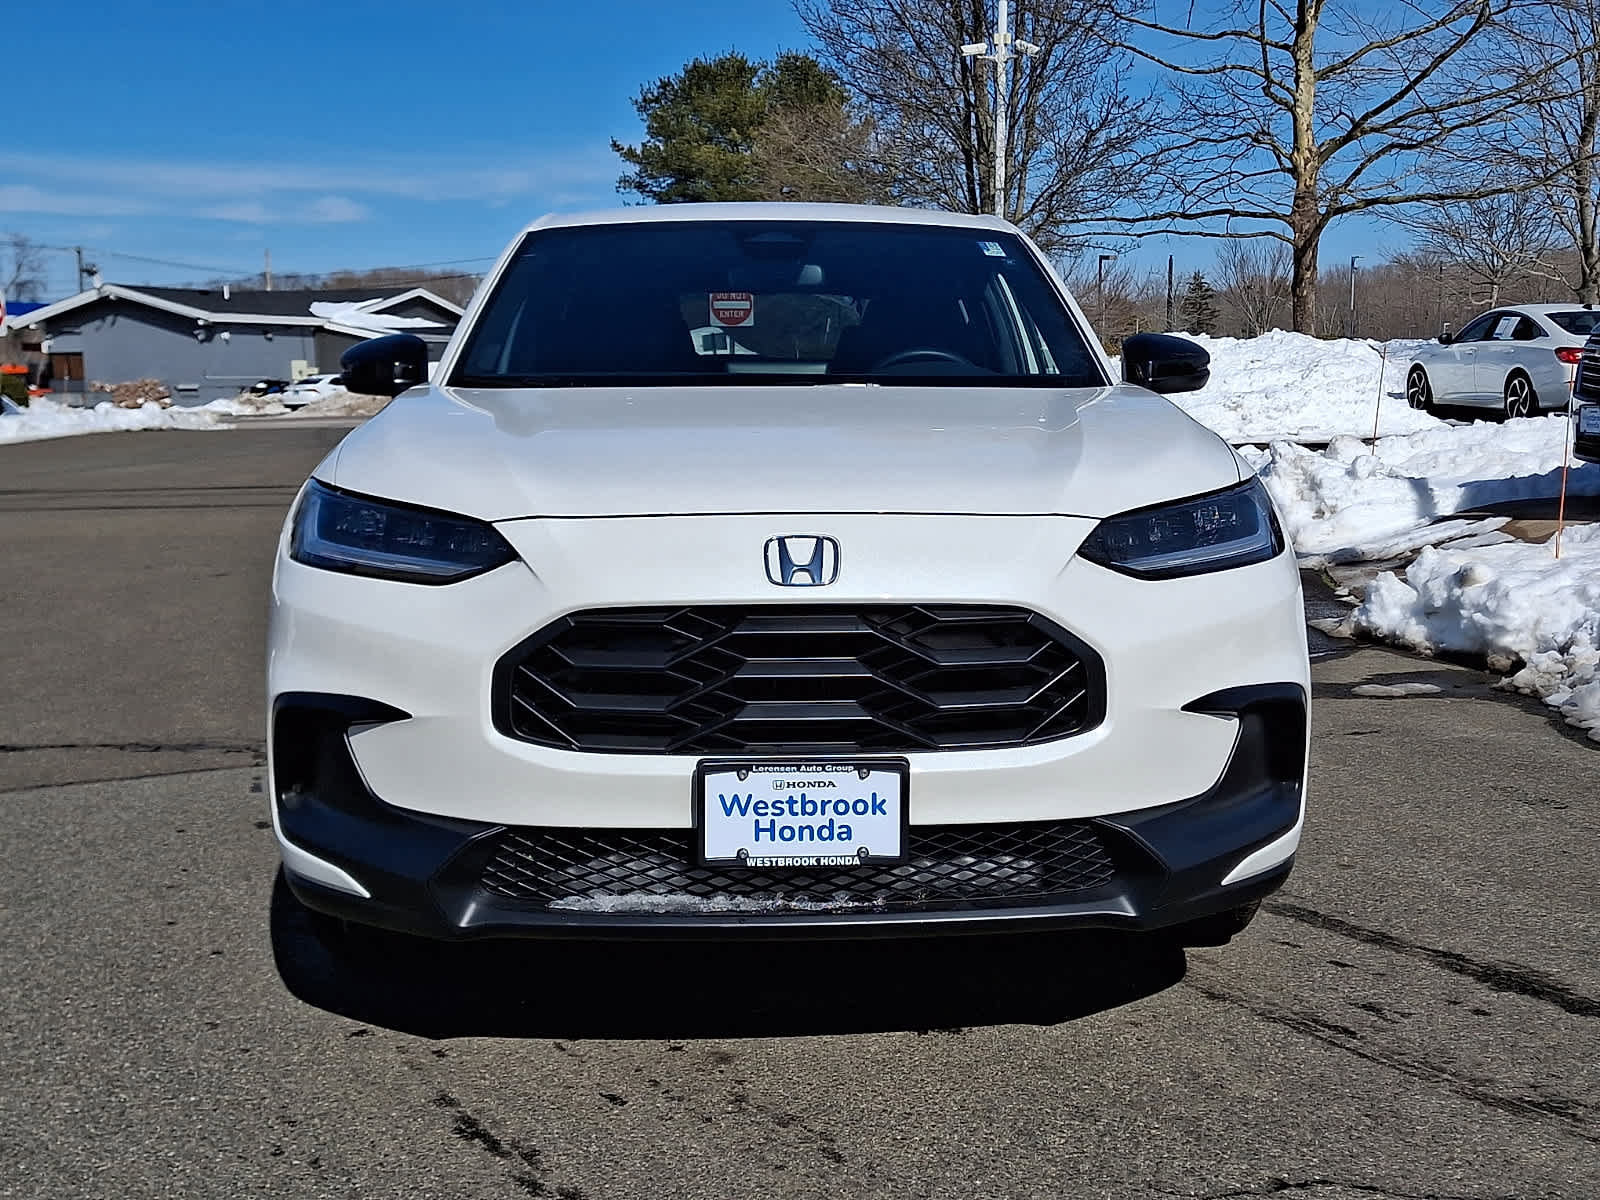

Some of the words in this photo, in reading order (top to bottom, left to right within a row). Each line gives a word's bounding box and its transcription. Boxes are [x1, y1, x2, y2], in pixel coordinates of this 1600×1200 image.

[719, 310, 745, 318] ENTER
[752, 765, 797, 773] Lorensen
[800, 765, 824, 773] Auto
[825, 765, 855, 774] Group
[719, 792, 887, 817] Westbrook
[754, 818, 852, 842] Honda
[746, 857, 818, 867] WESTBROOK
[821, 856, 860, 866] HONDA
